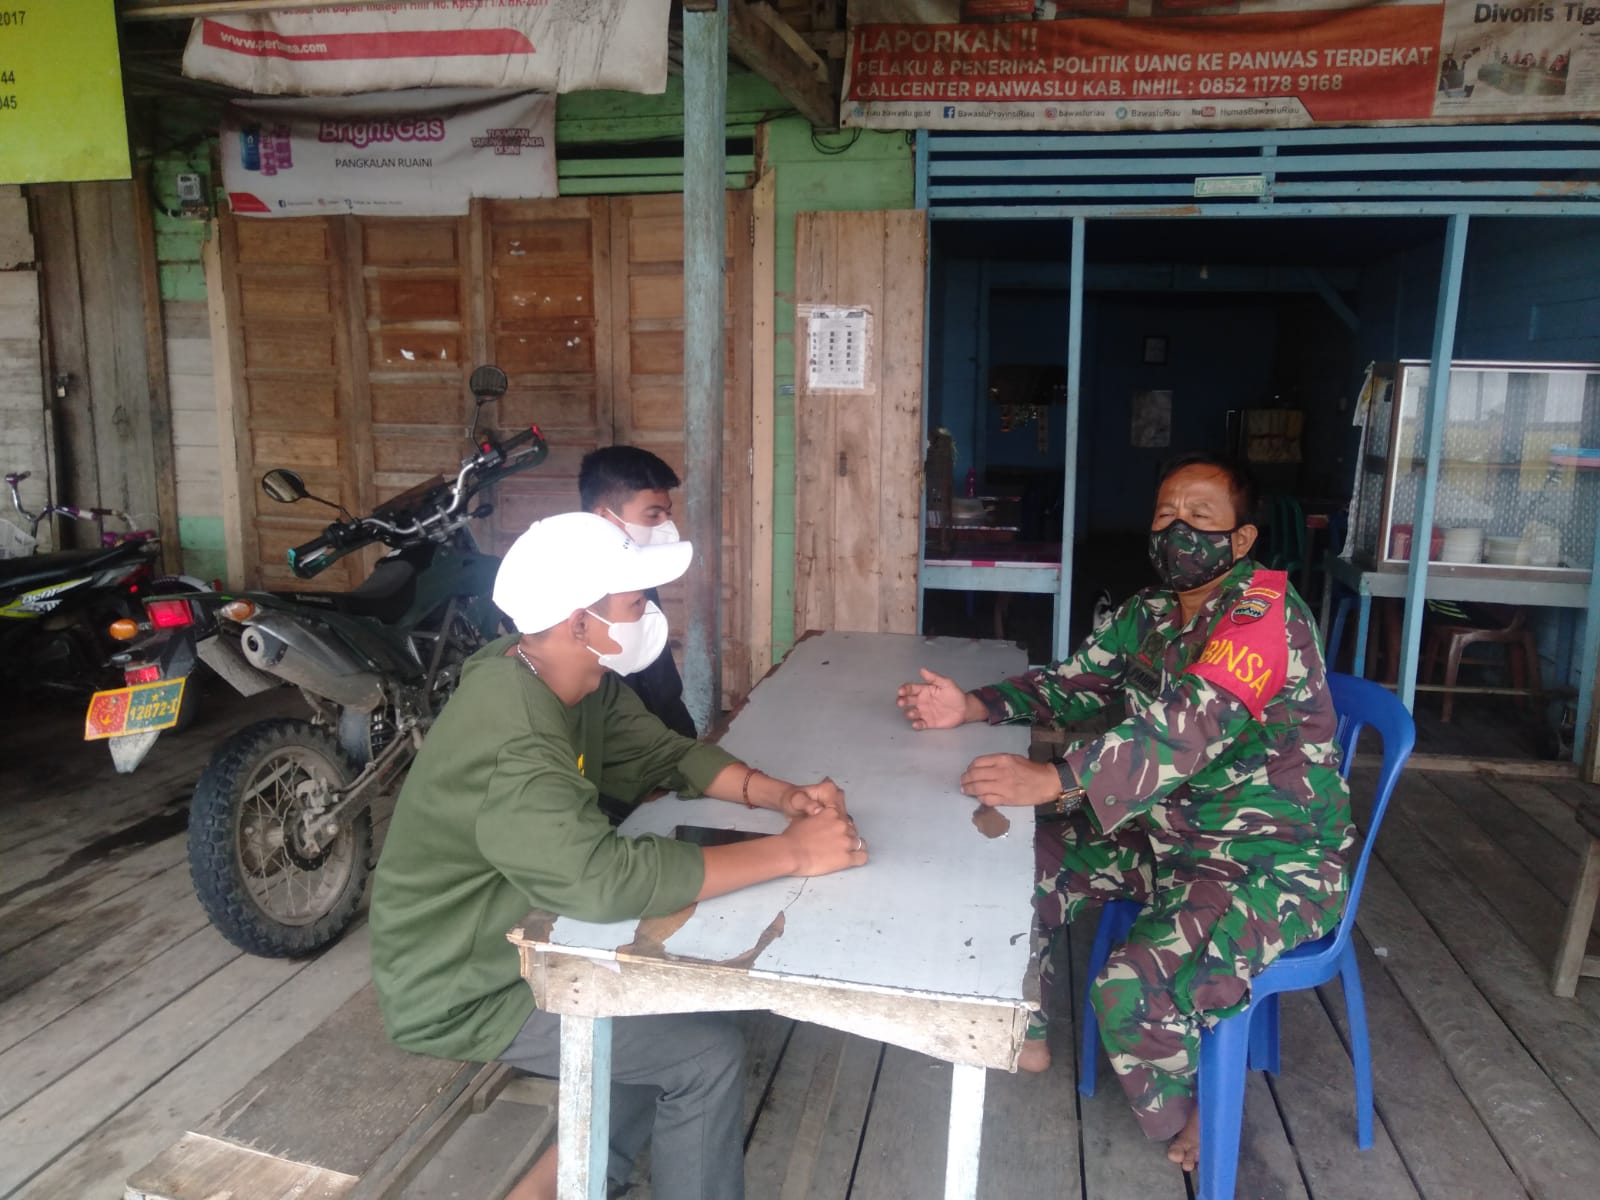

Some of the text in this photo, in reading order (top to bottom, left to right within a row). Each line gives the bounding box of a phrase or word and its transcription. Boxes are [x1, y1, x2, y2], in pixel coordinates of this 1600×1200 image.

[1474, 3, 1554, 23] Divonis
[860, 27, 1038, 54] LAPORKAN !!
[857, 46, 1433, 76] PELAKU & PENERIMA POLITIK UANG KE PANWAS TERDEKAT
[856, 74, 1342, 97] CALLCENTER PANWASLU KAB. INHIL : 0852 1178 9168
[1131, 107, 1181, 118] BawasluRiau
[321, 119, 443, 145] Bright Gas
[335, 157, 433, 169] PANGKALAN RUAINI
